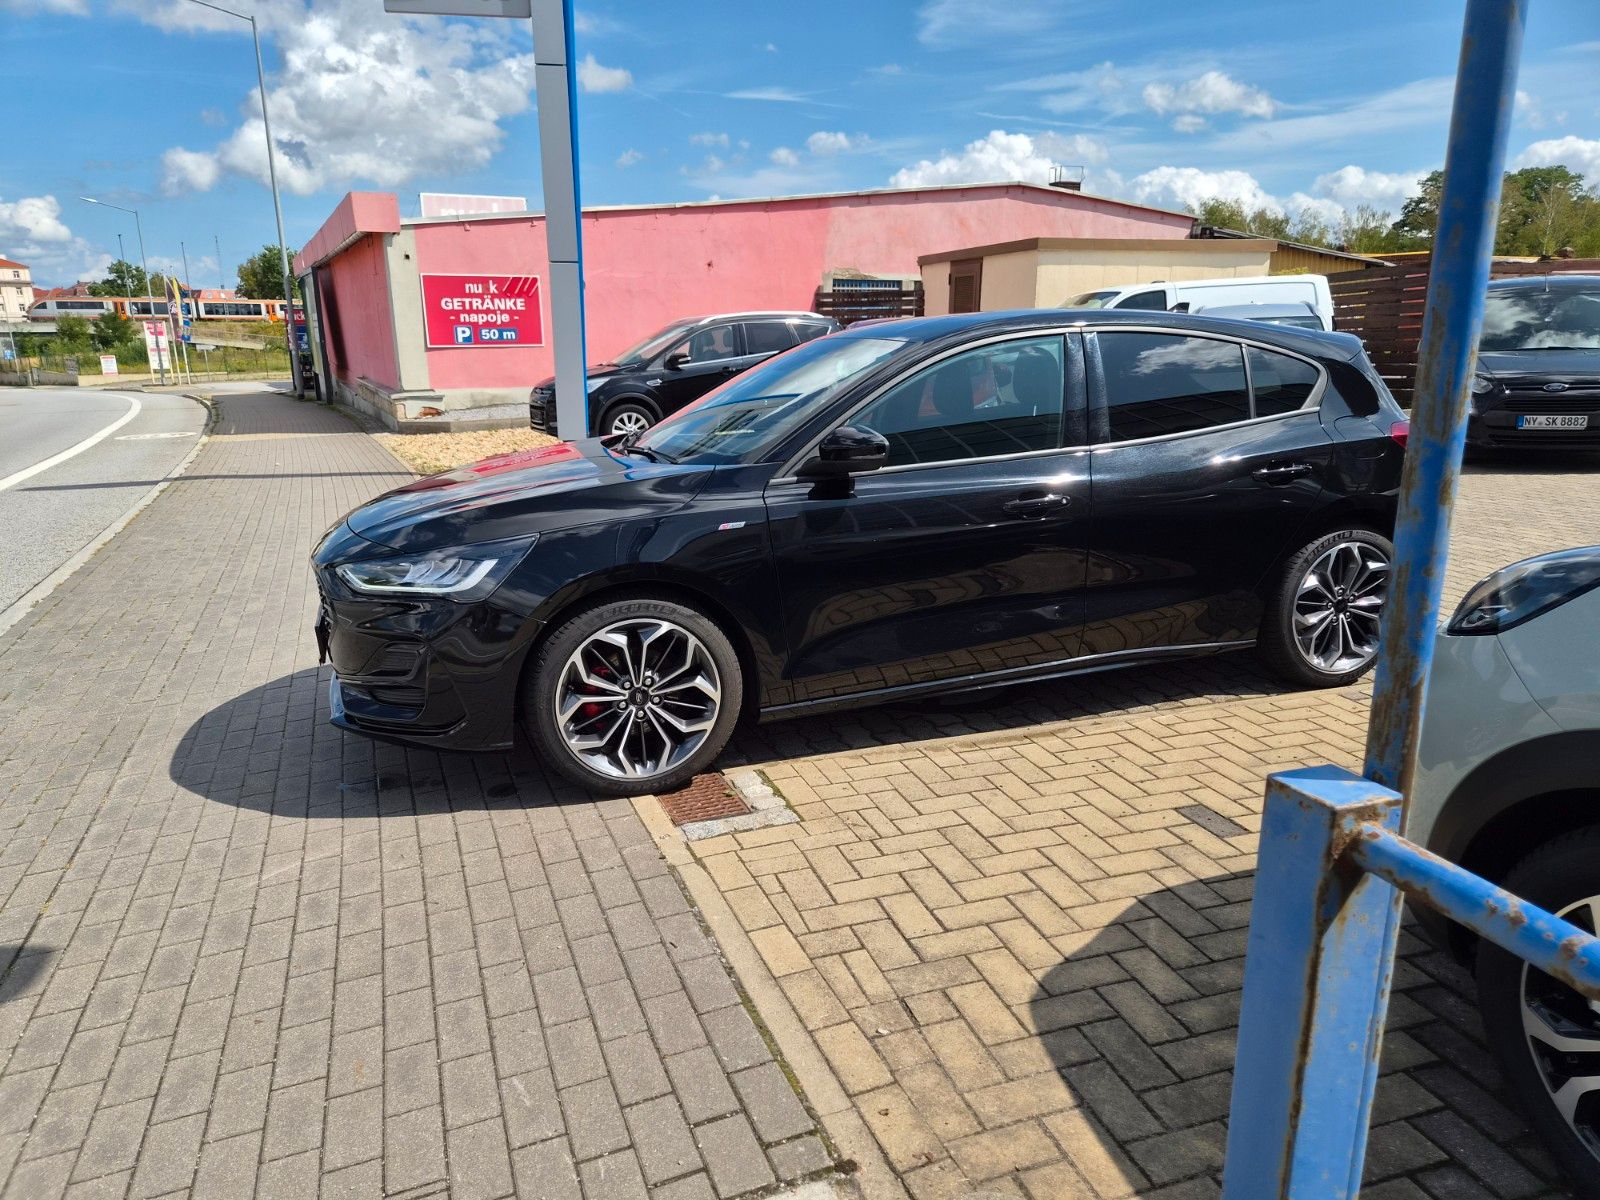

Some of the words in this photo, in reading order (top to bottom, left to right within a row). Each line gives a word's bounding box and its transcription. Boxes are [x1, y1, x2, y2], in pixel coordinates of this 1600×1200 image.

[441, 295, 525, 310] GETRÄNKE
[460, 311, 510, 325] napoje
[457, 327, 471, 342] P
[481, 329, 499, 340] 50
[503, 331, 516, 340] m
[1524, 416, 1538, 426] NY
[1545, 416, 1558, 427] SK
[1560, 416, 1586, 427] 8882
